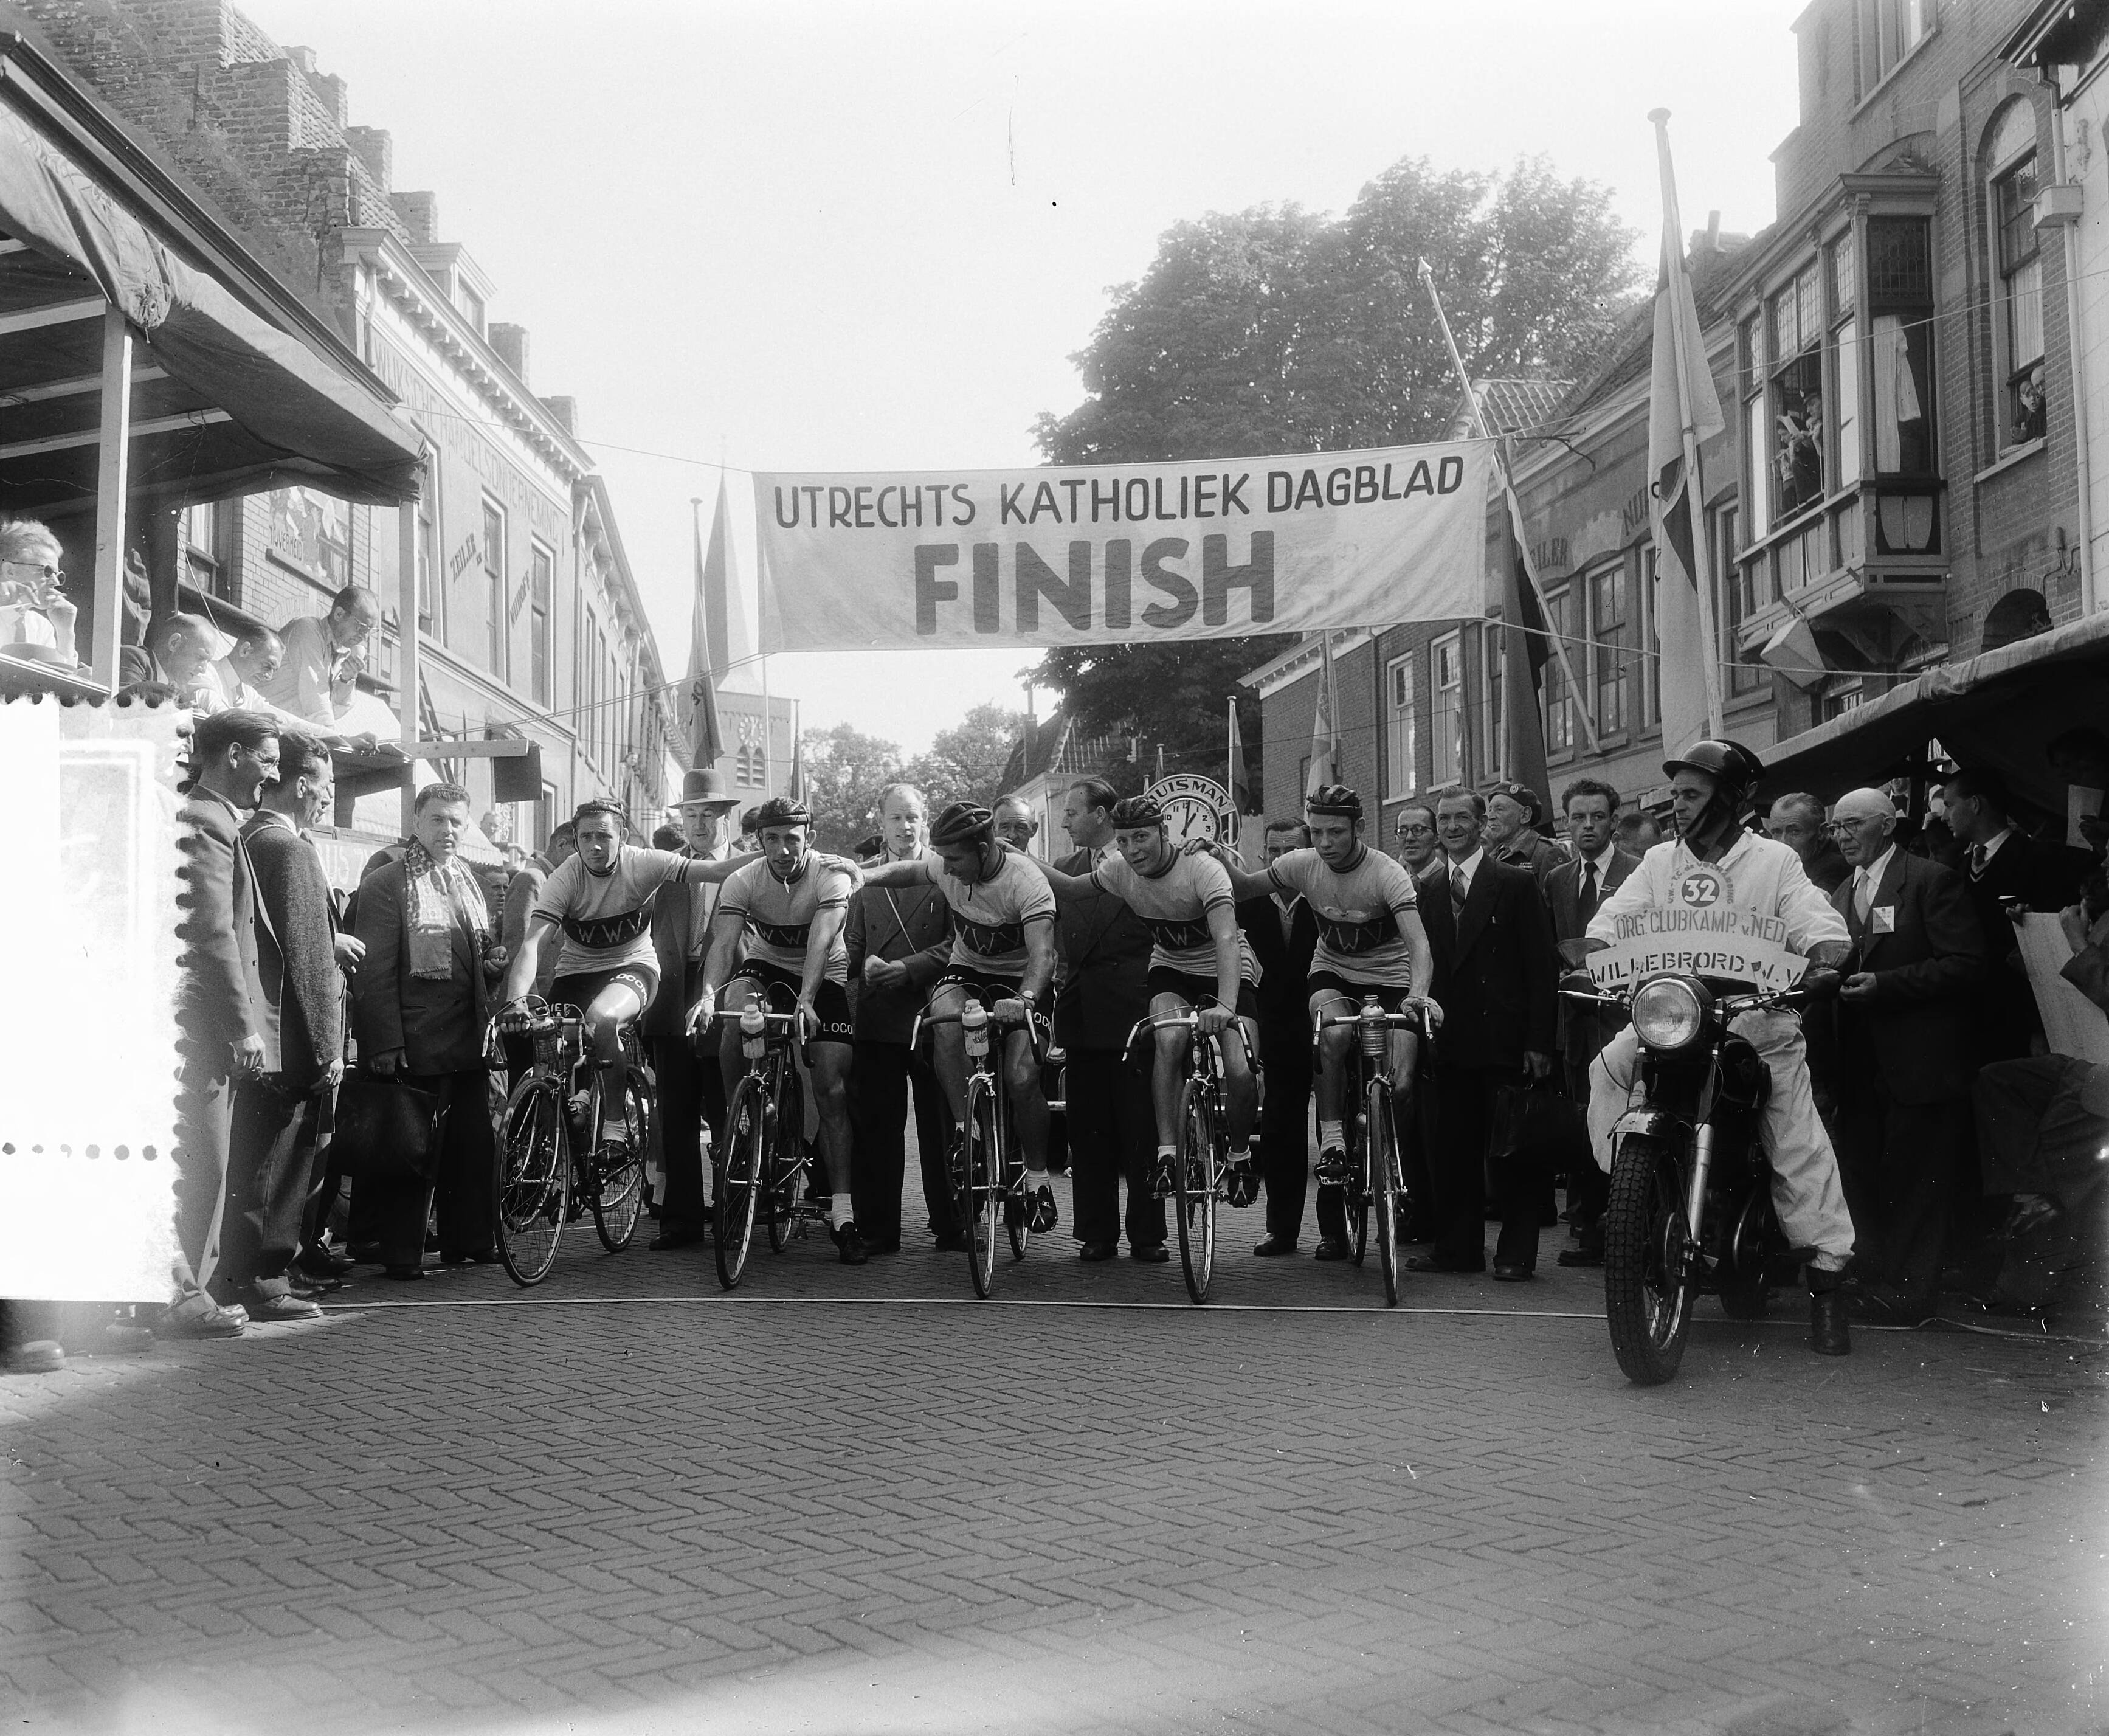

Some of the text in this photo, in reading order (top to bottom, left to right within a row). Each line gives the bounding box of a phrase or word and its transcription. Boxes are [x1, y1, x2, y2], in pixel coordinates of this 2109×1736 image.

[774, 456, 1465, 529] UTRECHTS KATHOLIEK DAGBLAD
[914, 530, 1275, 635] FINISH
[1149, 779, 1228, 809] UISMAN
[1684, 879, 1716, 902] 32
[1615, 914, 1648, 940] ORG.
[1649, 910, 1735, 933] CLUBKAMP.
[1590, 952, 1745, 985] WILLEBRORD
[823, 1022, 853, 1034] LOCO
